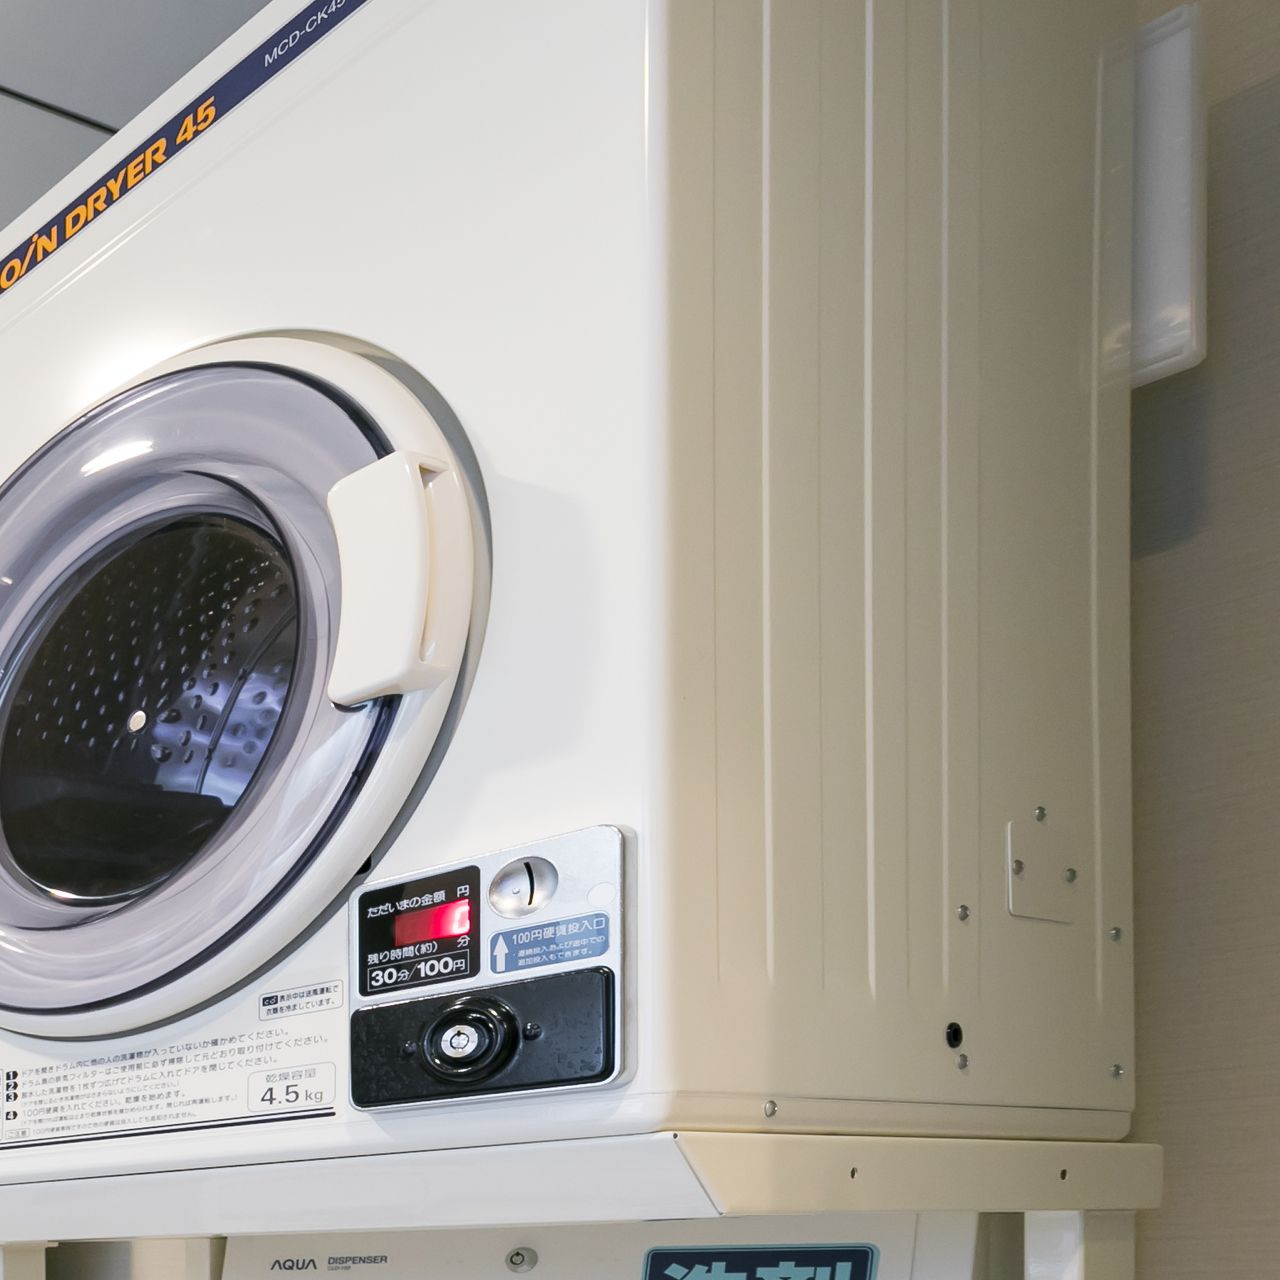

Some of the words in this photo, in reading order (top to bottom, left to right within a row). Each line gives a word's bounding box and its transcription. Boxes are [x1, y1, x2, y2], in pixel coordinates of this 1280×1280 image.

[64, 137, 167, 240] DRYER
[174, 96, 216, 145] 45
[457, 885, 471, 898] 円
[367, 890, 447, 919] ただいまの金額
[457, 934, 471, 949] 分
[512, 917, 607, 947] 100円硬貨投入口
[370, 957, 467, 987] 30分/100円
[265, 1068, 317, 1084] 乾燥容量
[261, 1084, 300, 1105] 4.5
[305, 1089, 324, 1104] kg
[270, 1258, 317, 1271] AQUA
[328, 1256, 388, 1265] DISPENSER
